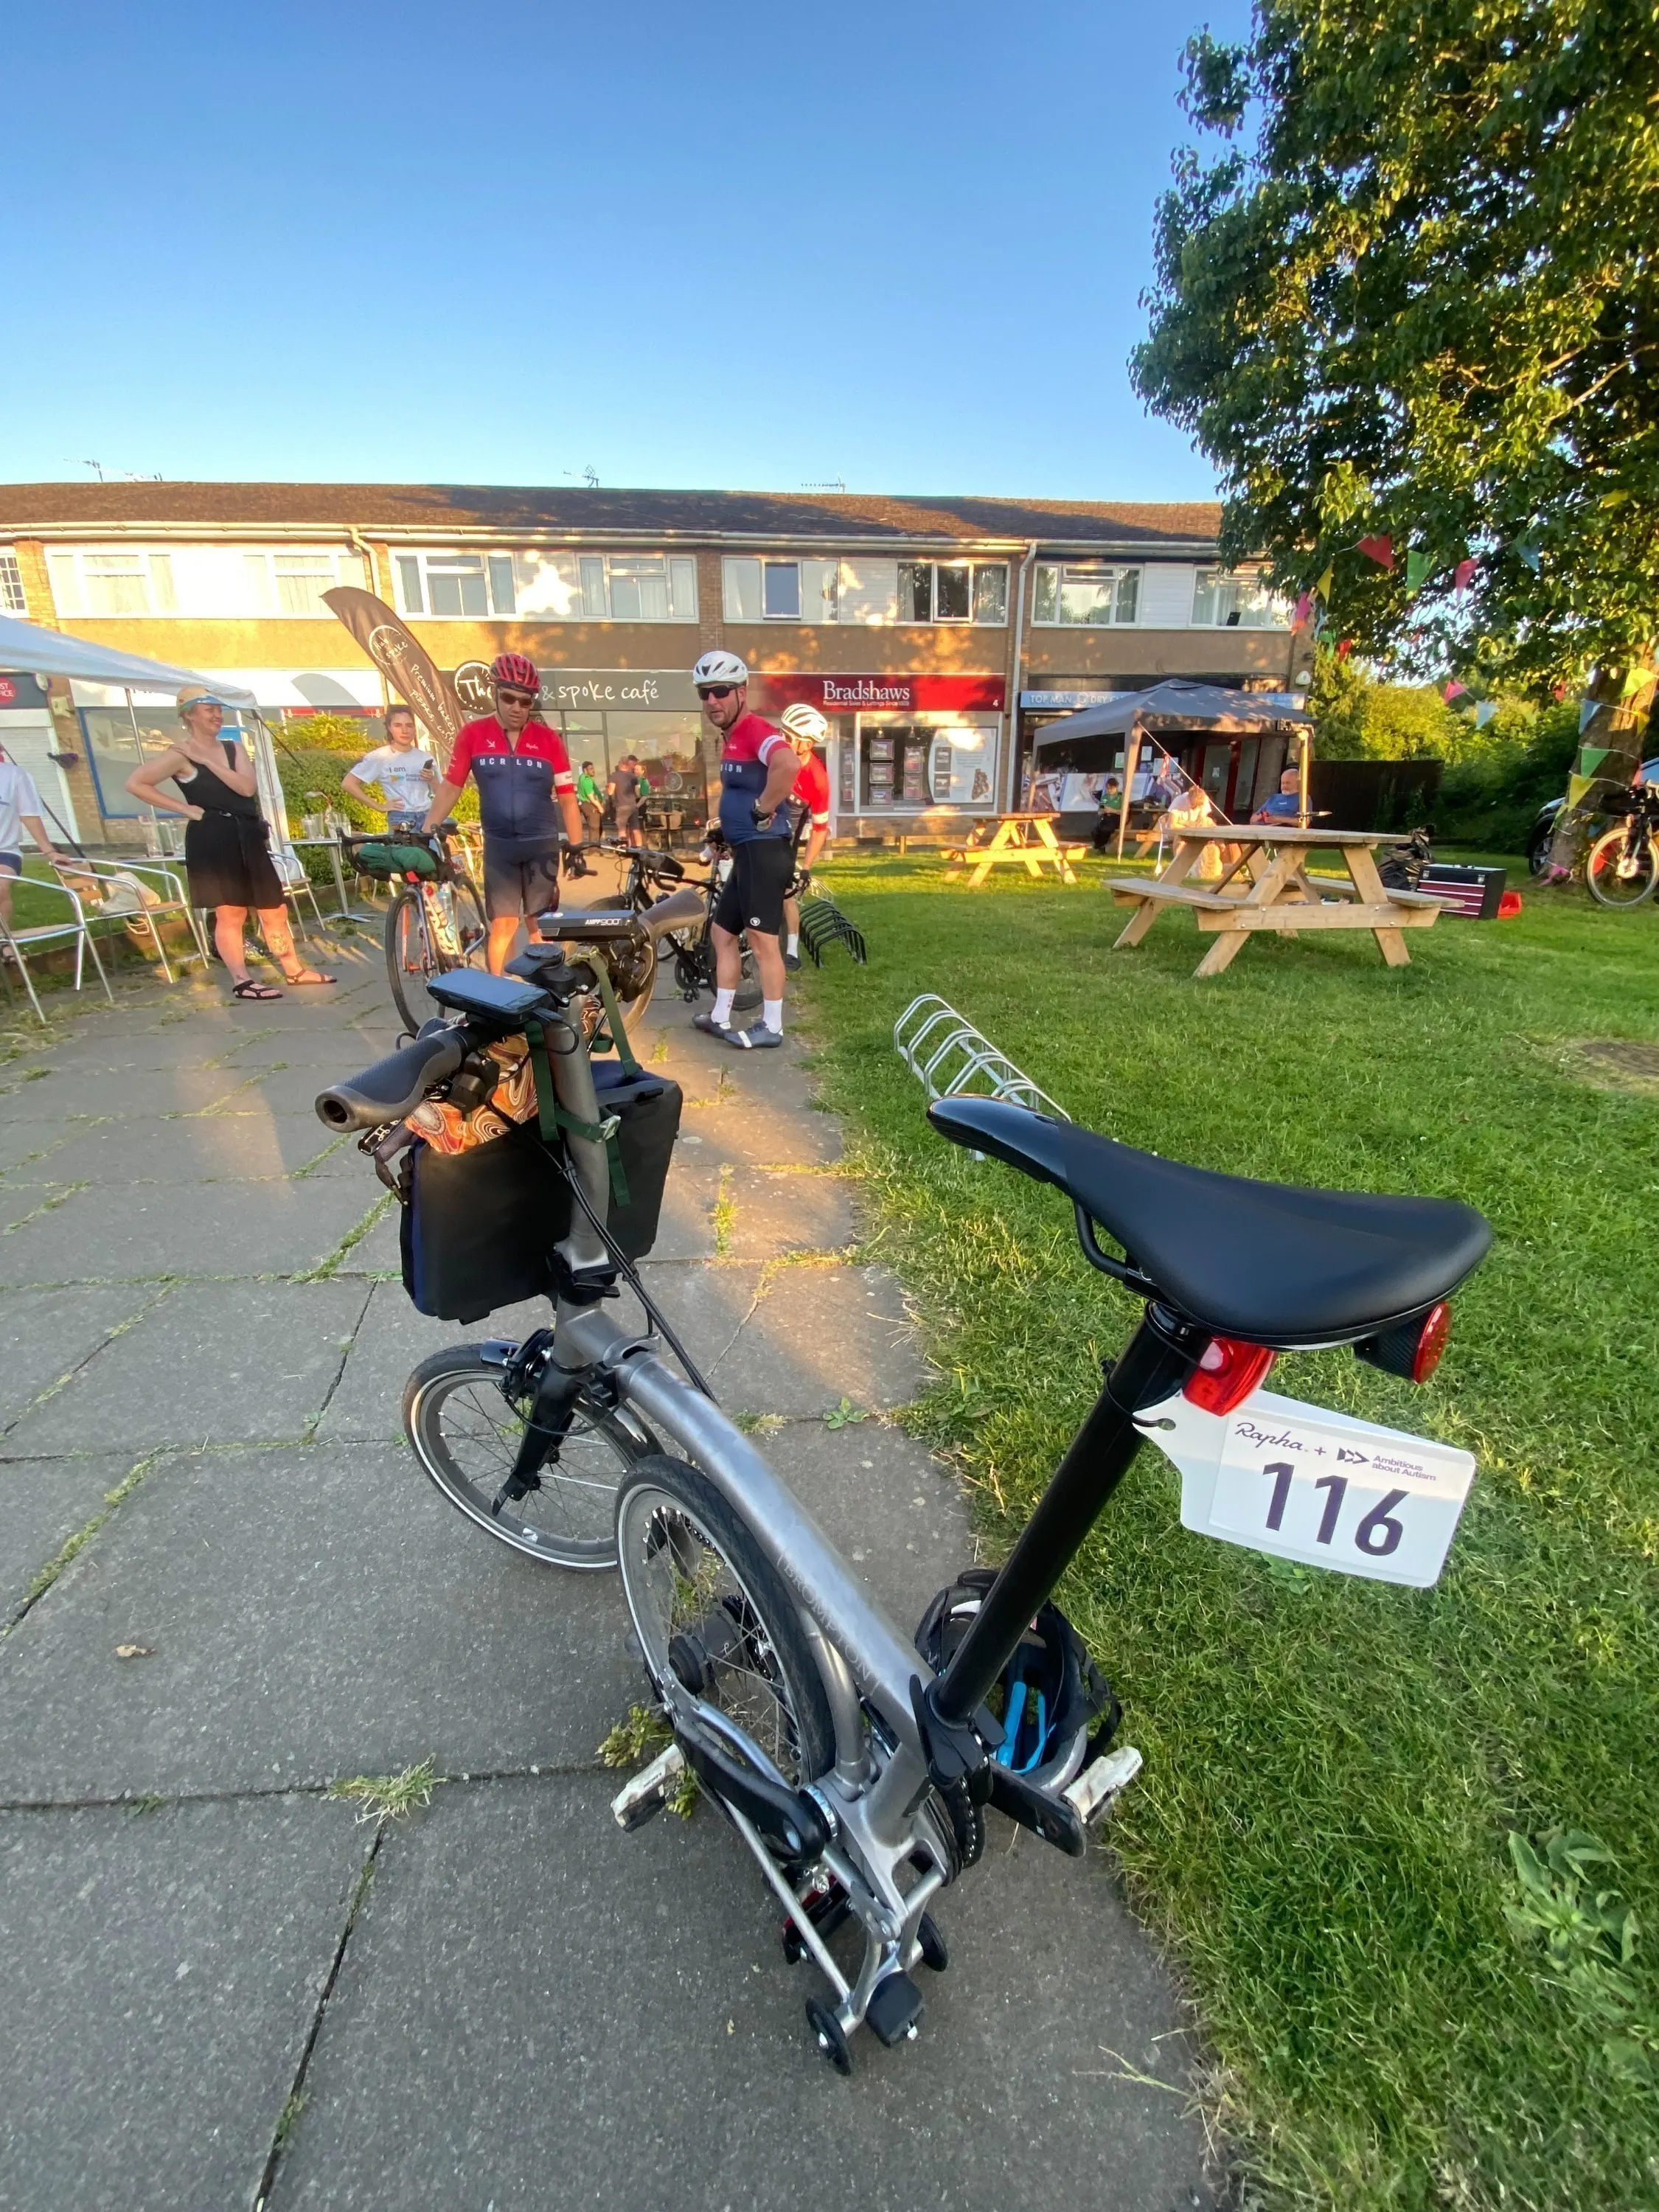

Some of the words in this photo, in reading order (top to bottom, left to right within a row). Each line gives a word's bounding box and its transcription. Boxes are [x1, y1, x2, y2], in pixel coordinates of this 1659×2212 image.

[374, 636, 389, 651] Hub
[386, 641, 408, 660] spoke
[411, 664, 436, 701] Premium
[822, 681, 910, 700] Bradshaws
[541, 685, 555, 700] &
[558, 681, 616, 708] spoke
[621, 680, 659, 704] café
[1029, 695, 1047, 703] TOP
[1051, 695, 1072, 703] MAN
[409, 689, 434, 723] pizzas,
[479, 757, 506, 766] MCR
[516, 759, 543, 768] LDN
[1371, 1462, 1400, 1474] about
[1402, 1468, 1437, 1481] Autism
[1373, 1455, 1424, 1472] Ambitious
[1262, 1461, 1411, 1557] 116
[784, 1559, 878, 1682] BROMPTON
